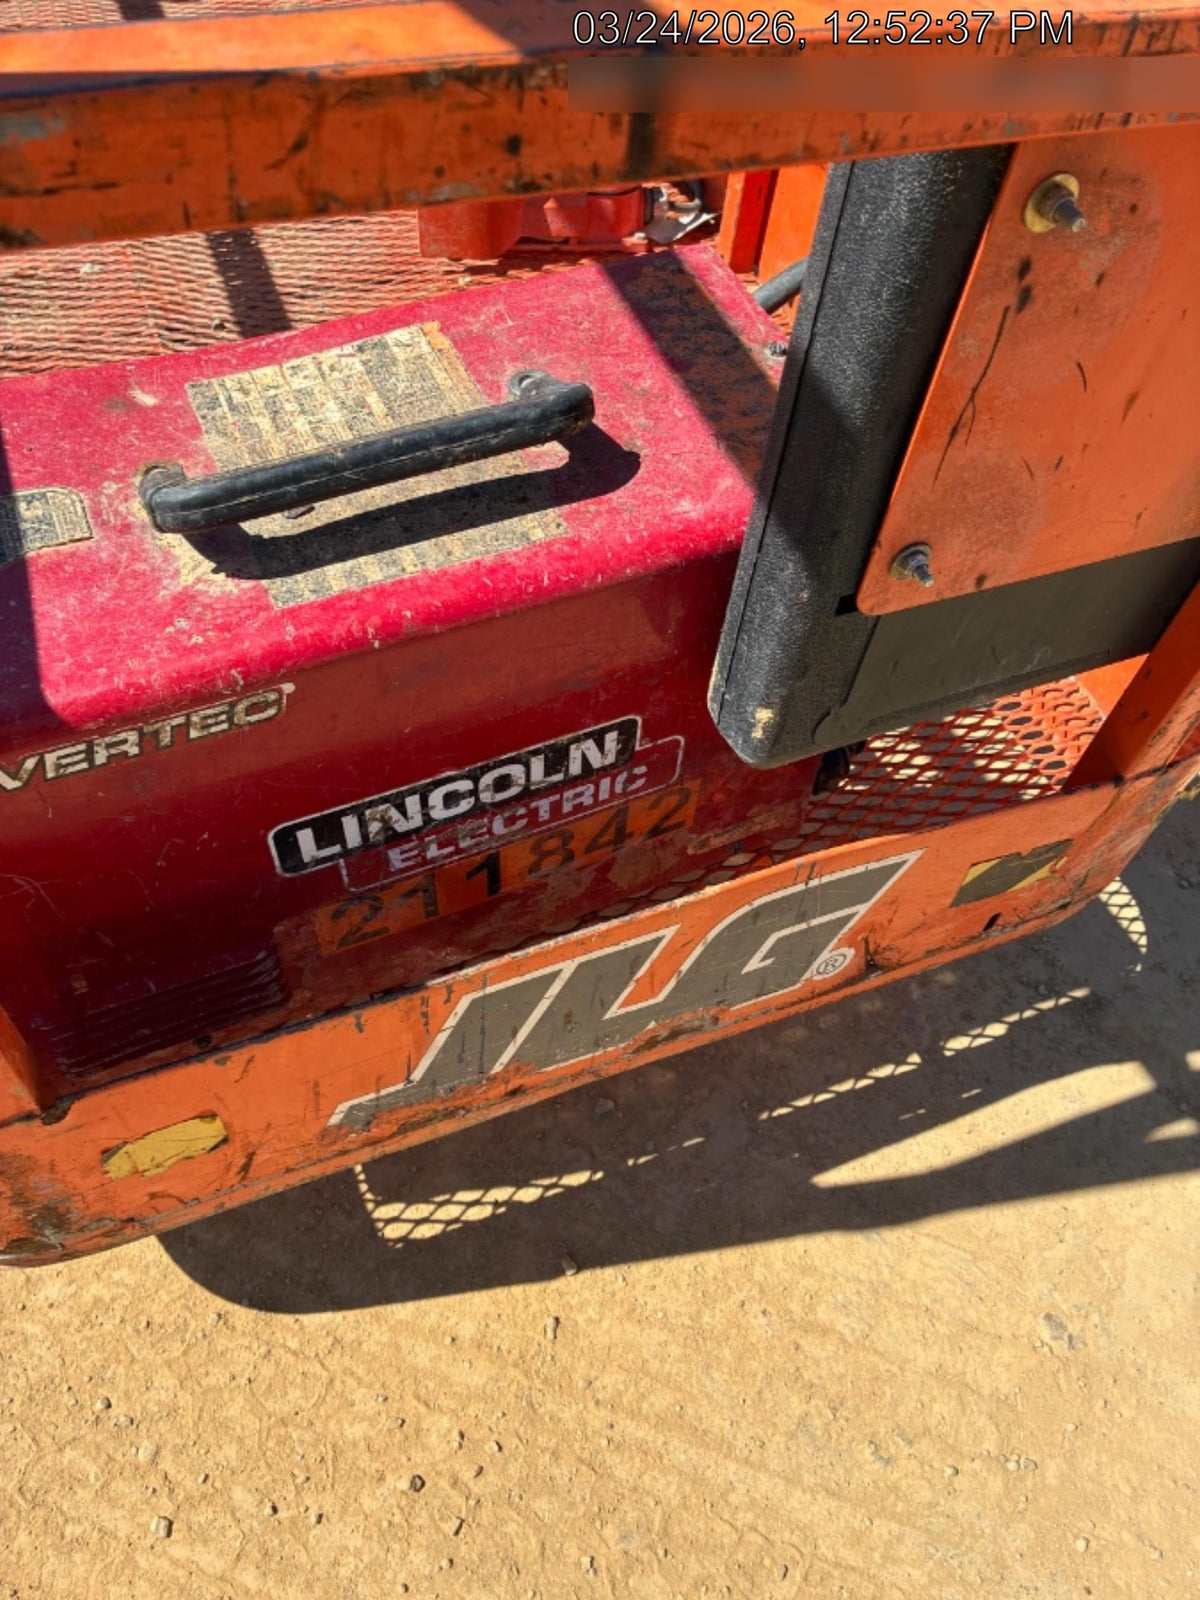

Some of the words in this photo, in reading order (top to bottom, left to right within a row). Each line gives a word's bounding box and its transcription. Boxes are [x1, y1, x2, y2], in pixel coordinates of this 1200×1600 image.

[296, 730, 619, 863] LINCOLN
[388, 764, 649, 873] ELECTRIC
[331, 786, 691, 947] 211842
